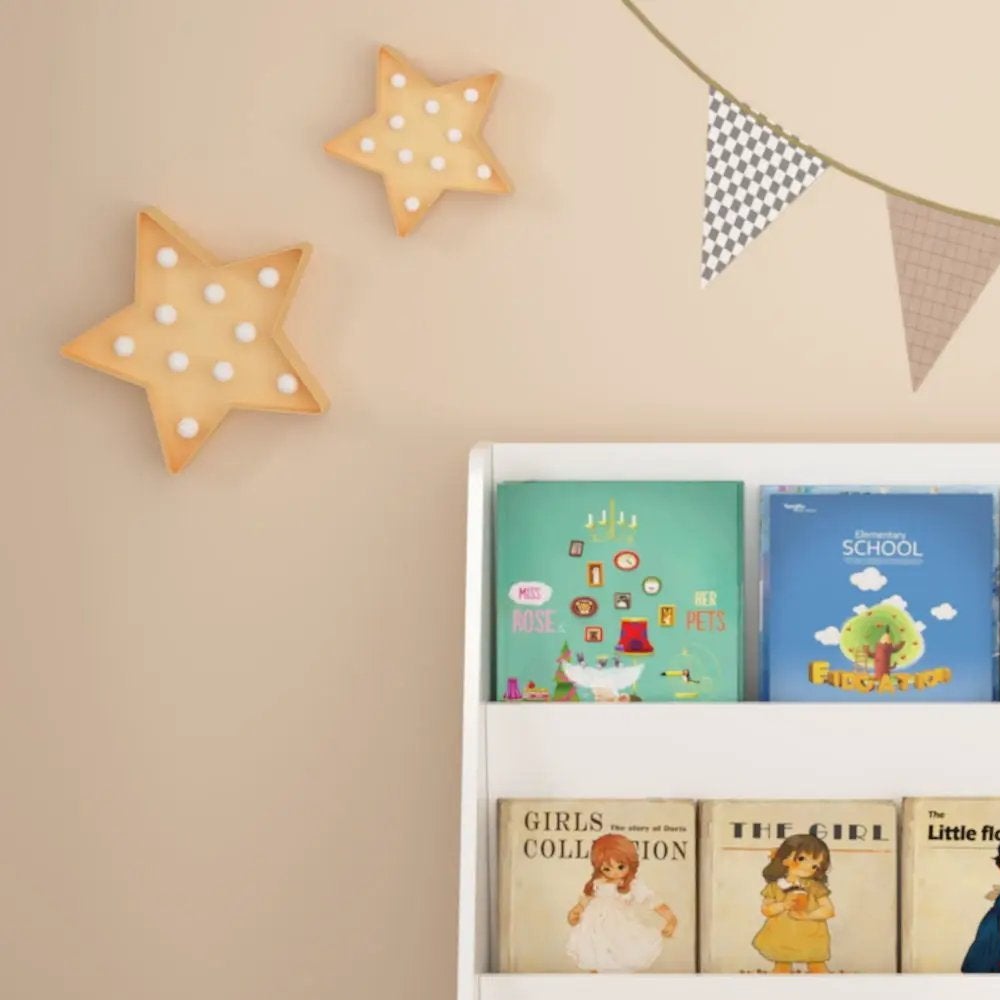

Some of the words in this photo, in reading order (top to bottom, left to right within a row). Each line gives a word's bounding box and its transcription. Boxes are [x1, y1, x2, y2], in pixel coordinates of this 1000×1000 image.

[855, 530, 906, 541] Elementary
[842, 539, 923, 557] SCHOOL
[518, 586, 541, 600] MISS
[694, 590, 717, 607] HER
[512, 608, 556, 634] ROSE
[686, 610, 727, 632] PETS
[524, 811, 603, 832] GIRLS
[928, 810, 945, 819] The
[808, 822, 889, 841] GIRL
[928, 824, 977, 841] Little
[523, 838, 688, 860] COLLION
